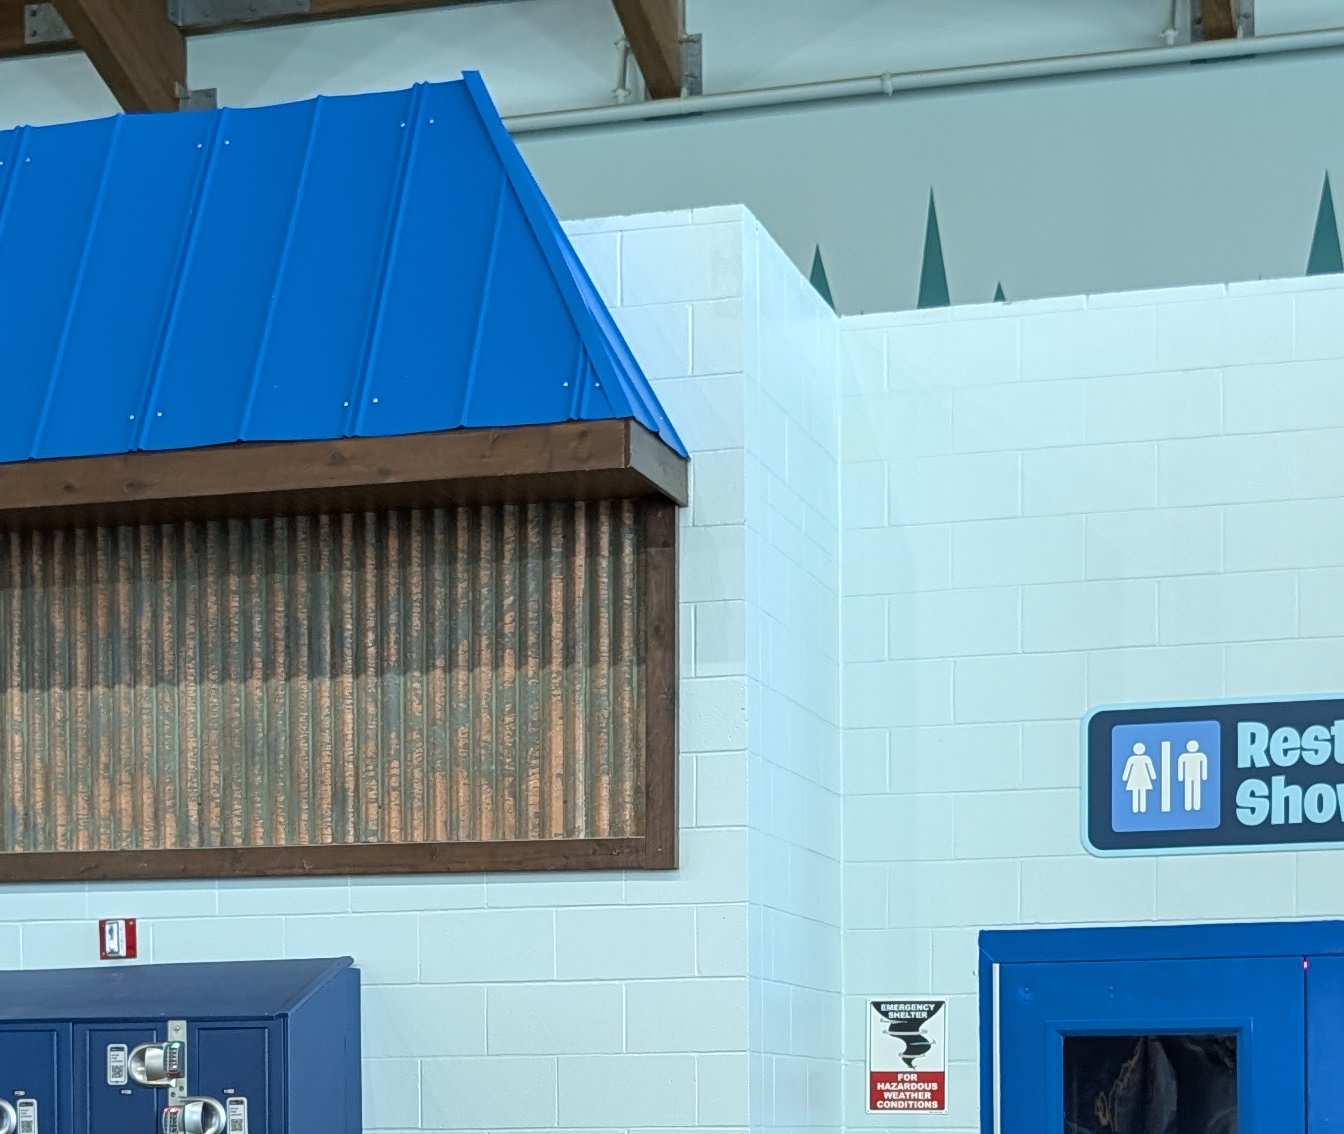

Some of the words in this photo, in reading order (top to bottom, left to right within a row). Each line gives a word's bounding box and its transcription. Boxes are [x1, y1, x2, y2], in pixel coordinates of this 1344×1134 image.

[880, 1003, 935, 1012] EMERGENCY
[888, 1011, 927, 1019] SHELTER
[897, 1073, 918, 1081] FOR
[876, 1082, 938, 1091] HAZARDOUS
[883, 1091, 931, 1100] WEATHER
[876, 1100, 938, 1109] CONDITIONS
